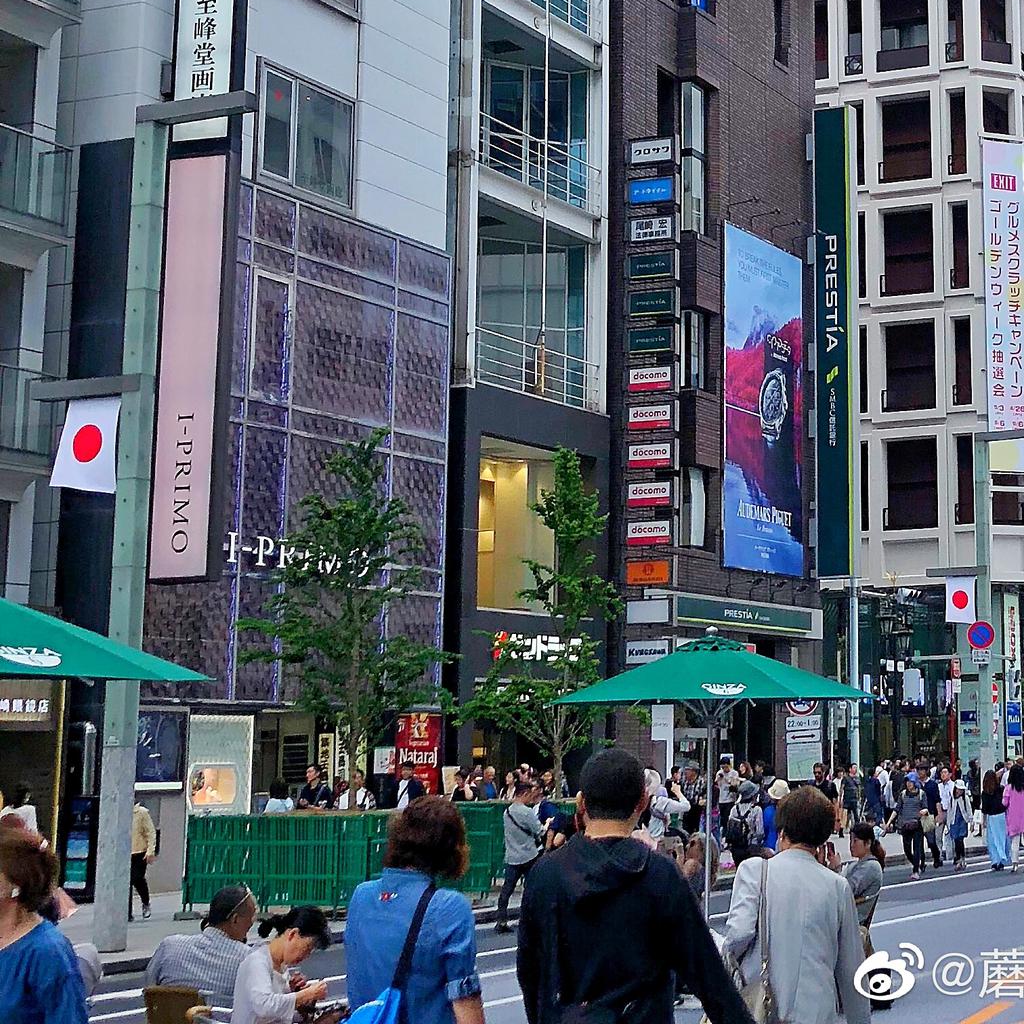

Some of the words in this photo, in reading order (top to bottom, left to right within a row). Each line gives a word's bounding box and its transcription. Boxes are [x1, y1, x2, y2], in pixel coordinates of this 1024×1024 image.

[633, 145, 670, 156] クロサワ
[993, 175, 1016, 191] EXIT
[989, 199, 1006, 398] ゴールデンウィーク抽選会
[1007, 201, 1024, 399] グルメスクラッチキャンペーン
[633, 370, 668, 381] docomo
[632, 408, 668, 419] docomo
[632, 447, 668, 458] docomo
[171, 413, 195, 554] I-PRIMO
[631, 485, 667, 496] docomo
[631, 524, 667, 535] docomo
[225, 531, 370, 578] I-PRM
[0, 646, 63, 658] INZA
[398, 747, 438, 769] Nataraj
